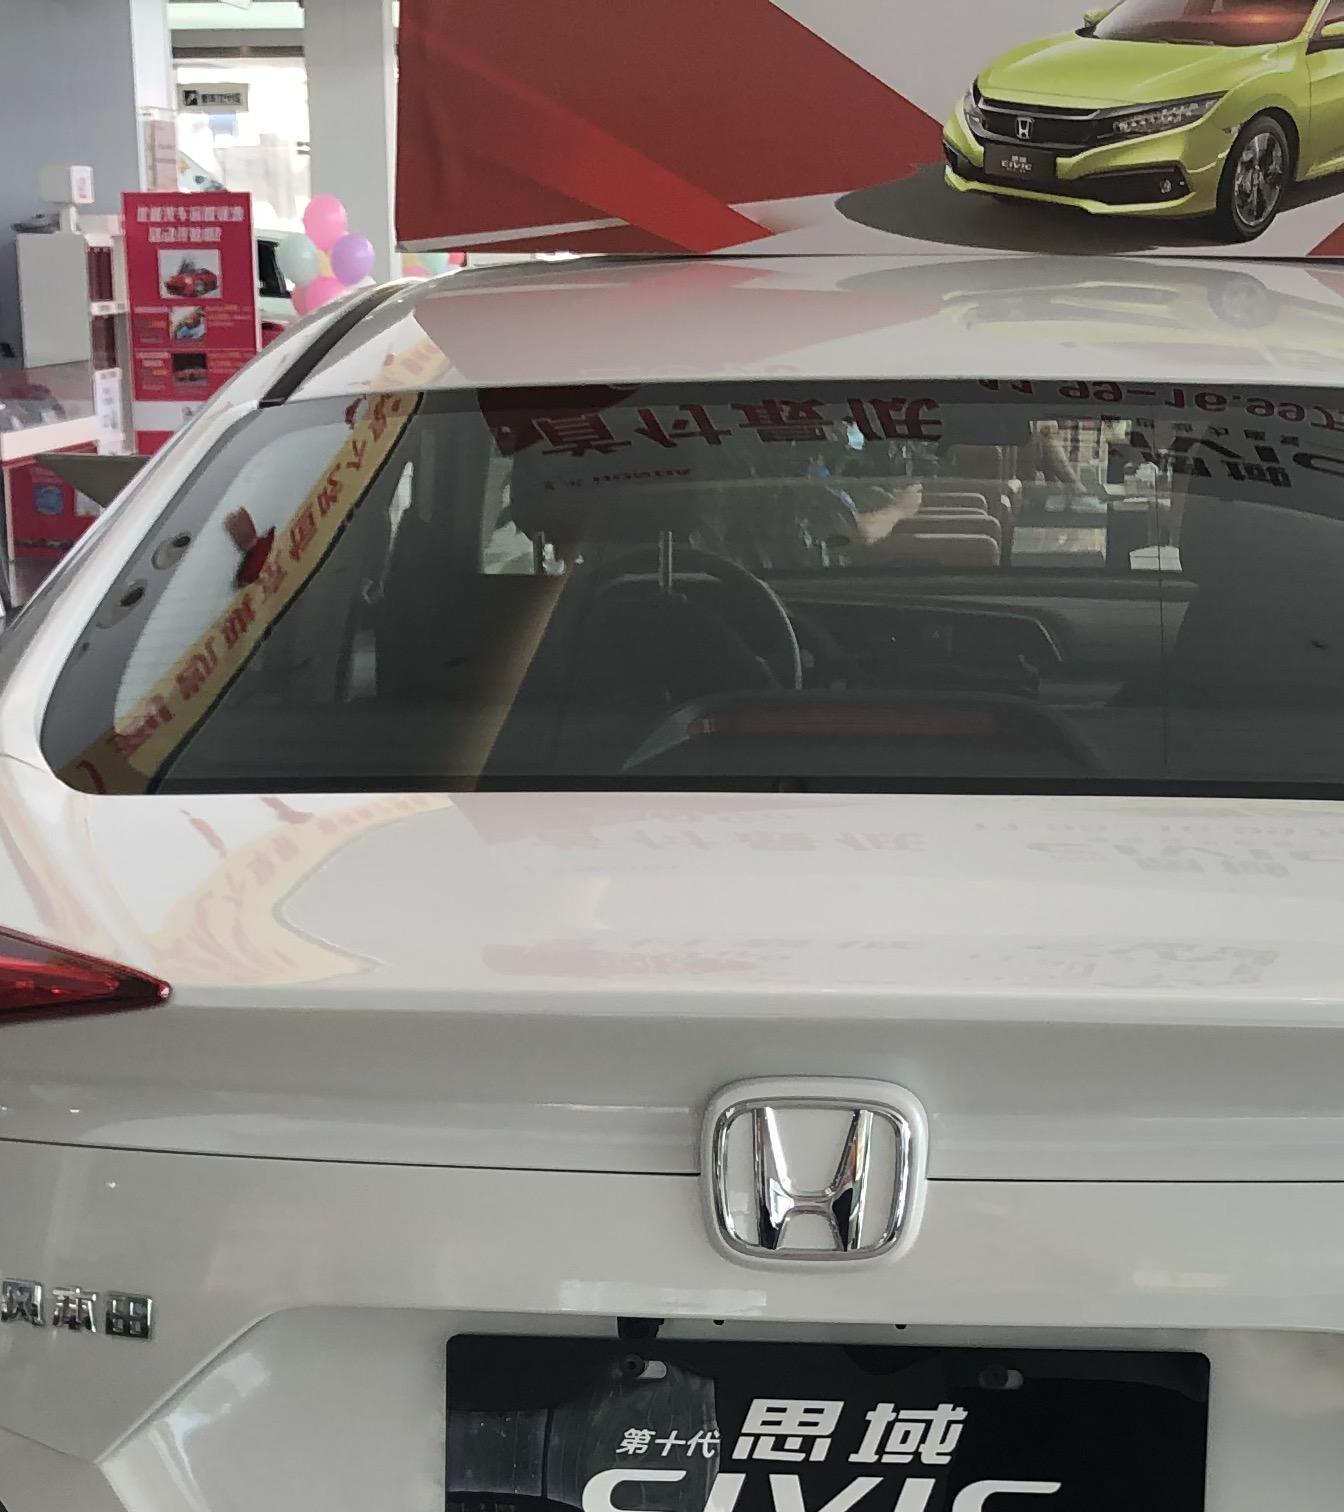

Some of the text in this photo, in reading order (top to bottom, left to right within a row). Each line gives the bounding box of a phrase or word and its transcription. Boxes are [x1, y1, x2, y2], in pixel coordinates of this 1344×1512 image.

[1001, 159, 1032, 171] CIVIC
[615, 1397, 968, 1465] 第十代 思域
